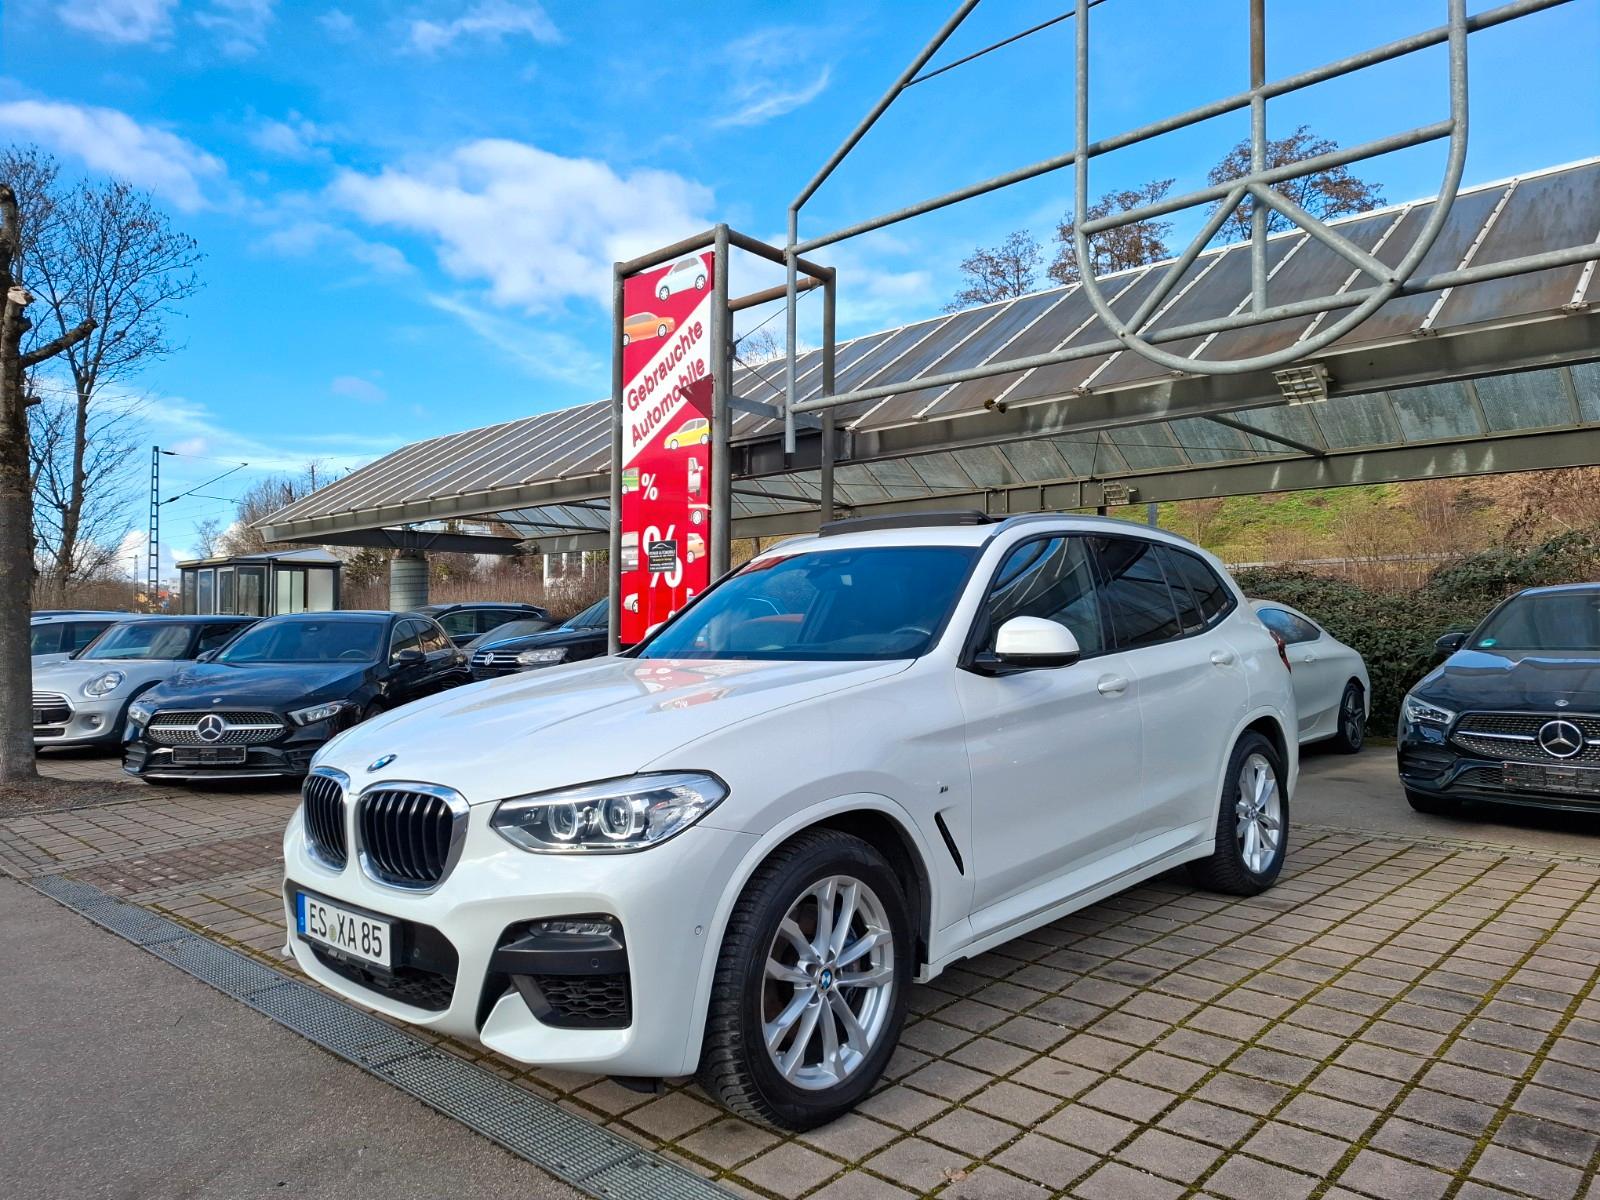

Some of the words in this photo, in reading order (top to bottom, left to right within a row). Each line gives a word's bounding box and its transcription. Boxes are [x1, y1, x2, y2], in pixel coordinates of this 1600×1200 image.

[627, 320, 703, 411] Gebrauchte
[309, 903, 327, 937] ES
[337, 913, 357, 950] XA
[361, 921, 382, 958] 85
